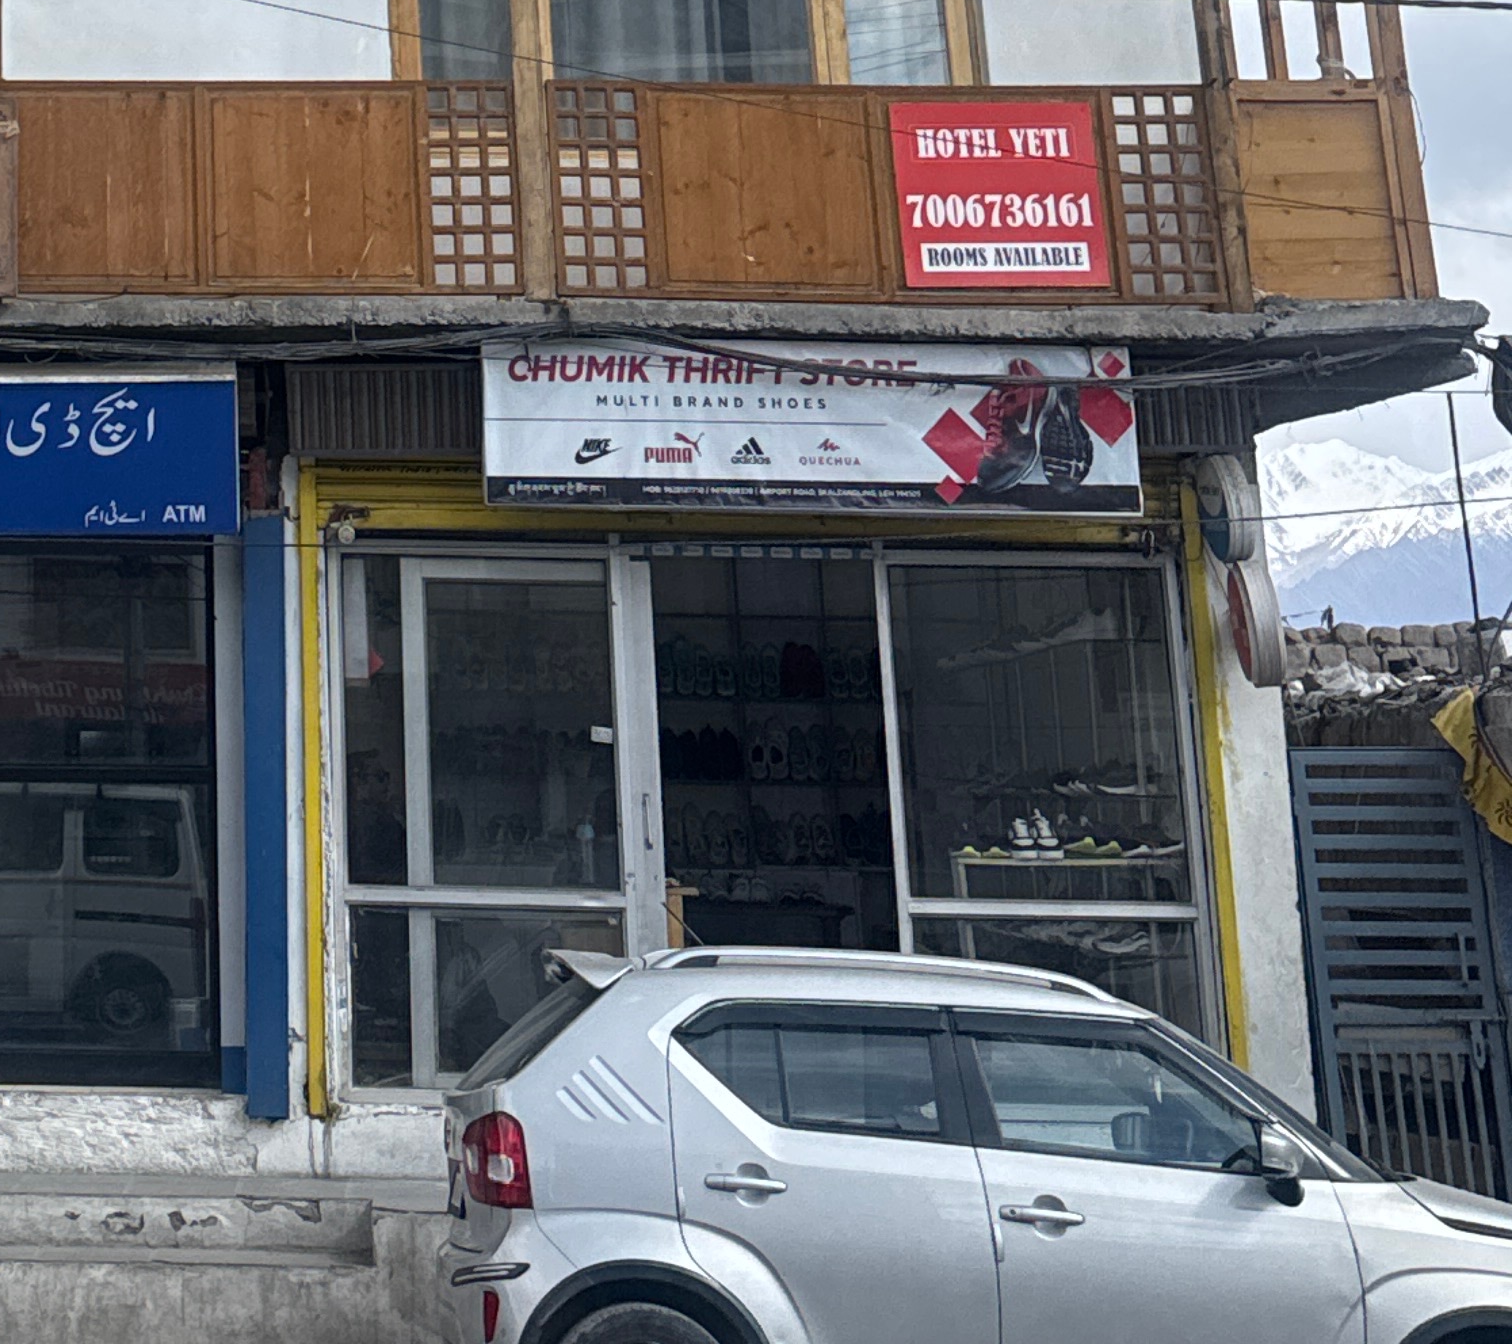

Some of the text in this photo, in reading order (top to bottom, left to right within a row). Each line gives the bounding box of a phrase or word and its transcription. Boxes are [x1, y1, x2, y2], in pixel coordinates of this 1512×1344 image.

[915, 127, 1071, 159] HOTEL YETI
[905, 192, 1094, 229] 7006736161
[926, 245, 1084, 267] ROOMS AVAILABLE
[508, 354, 650, 383] CHUMIK
[595, 394, 827, 410] MULTI BRAND SHOES
[643, 446, 694, 464] PUMA
[730, 454, 772, 465] adidas
[798, 456, 862, 466] QUECHUA
[161, 504, 207, 524] ATM
